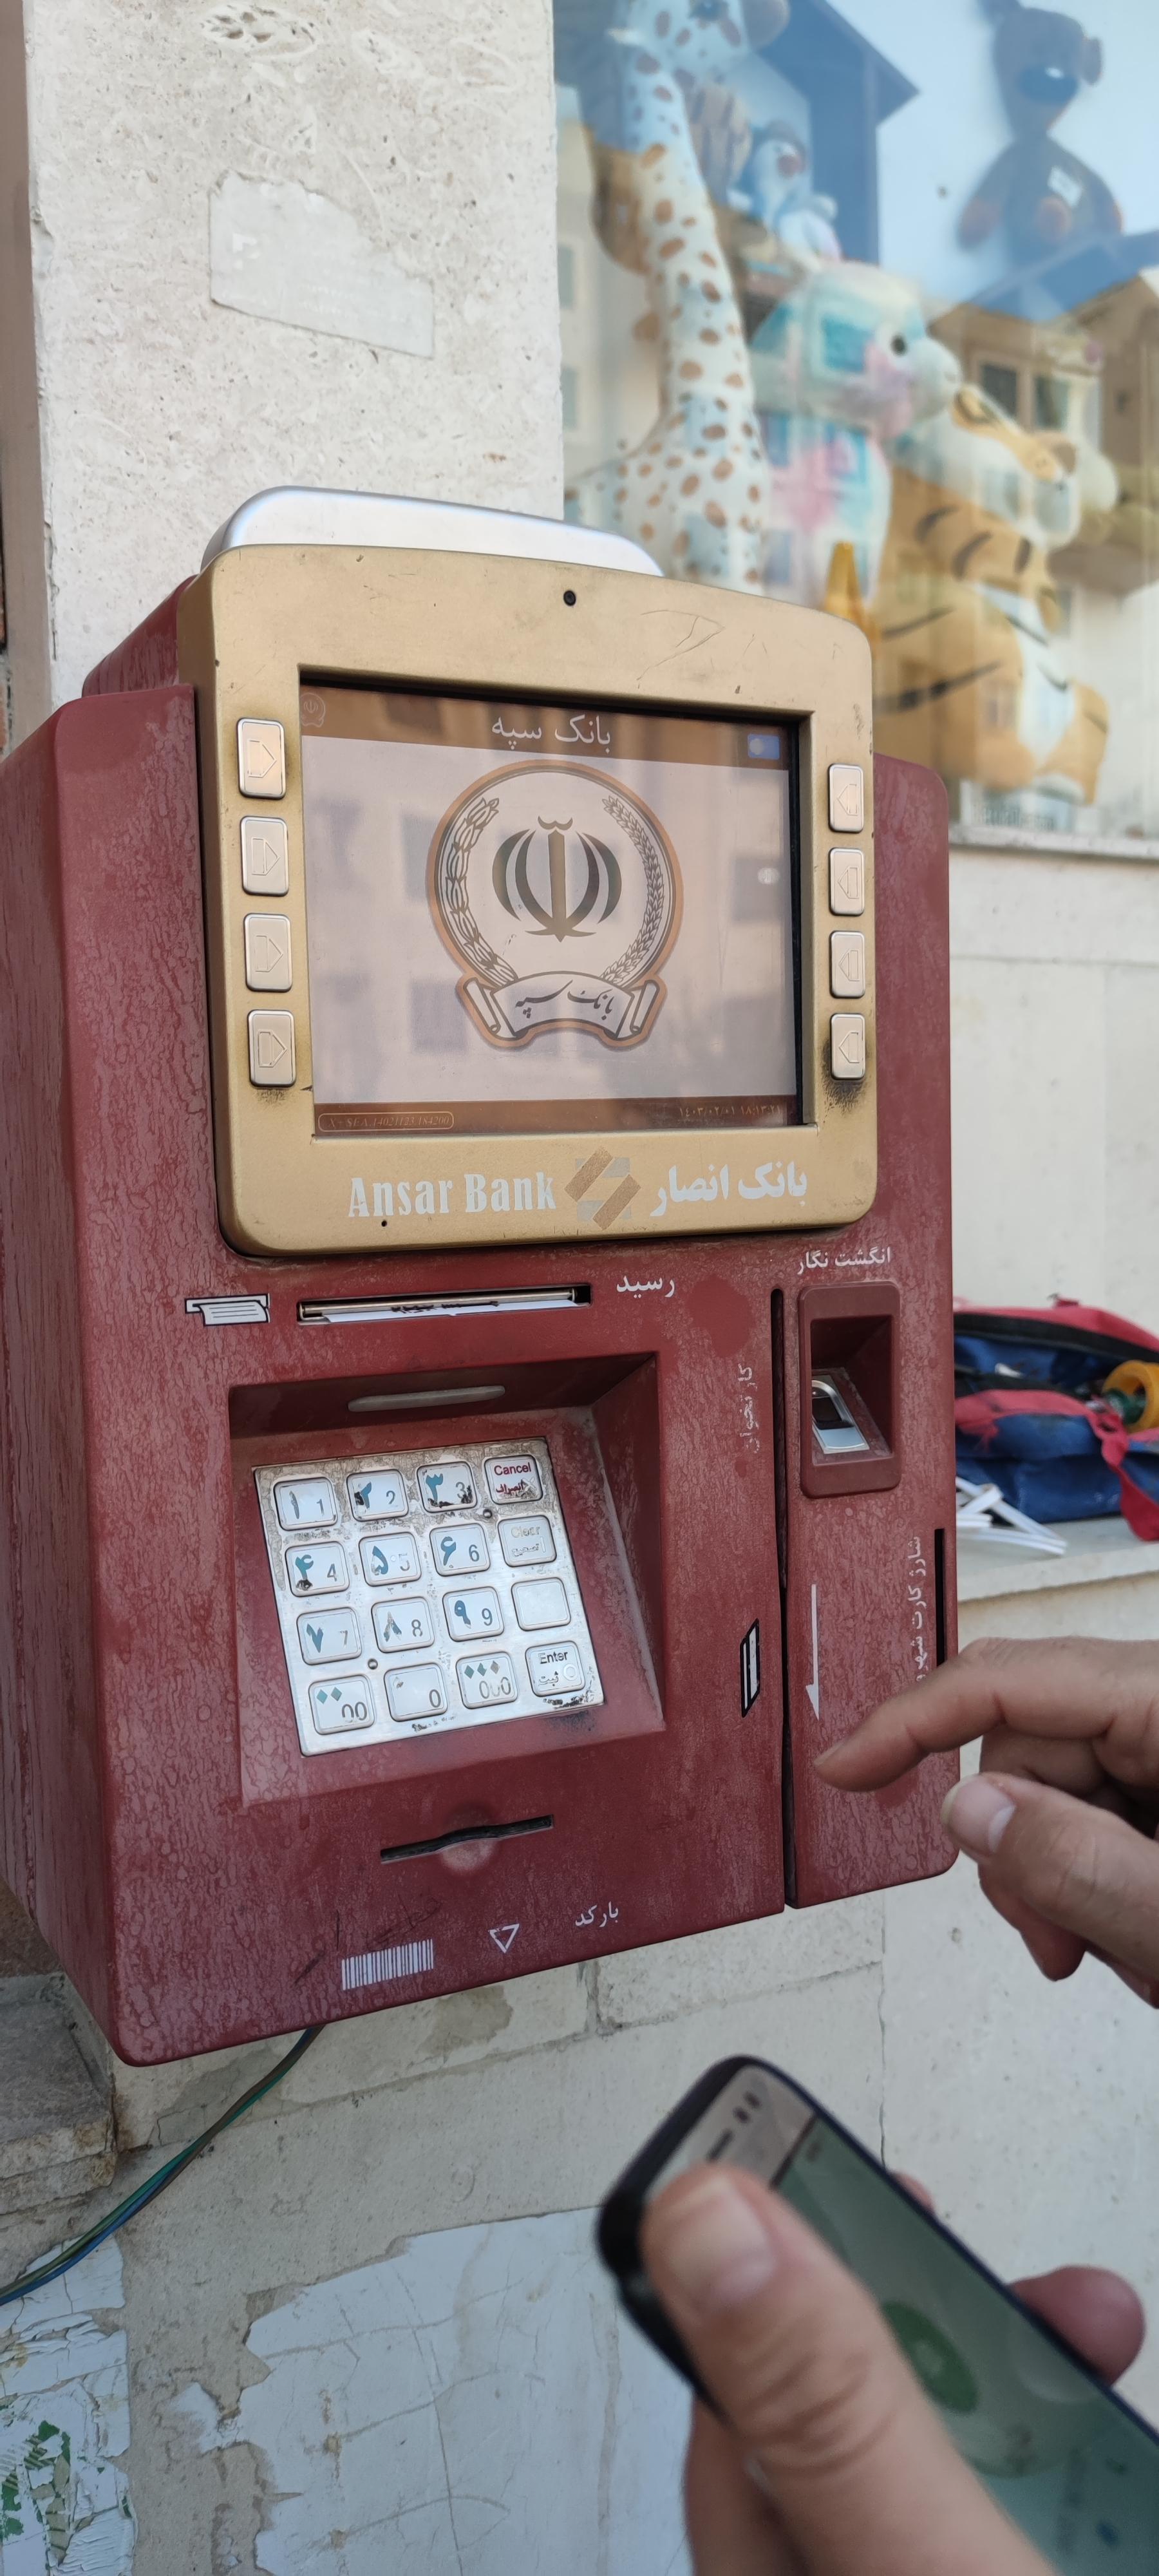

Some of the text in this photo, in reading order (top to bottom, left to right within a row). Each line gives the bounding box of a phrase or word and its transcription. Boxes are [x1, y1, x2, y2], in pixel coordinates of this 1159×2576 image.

[491, 715, 611, 753] بانک سپه
[515, 980, 615, 1021] بانک سپه
[348, 1171, 556, 1217] Ansar Bank
[650, 1160, 808, 1217] بانک انصار
[797, 1247, 891, 1275] انگشت نگار
[615, 1275, 676, 1298] رسید
[494, 1462, 532, 1476] Cancel
[386, 1490, 396, 1505] 2
[426, 1473, 466, 1502] ۳ 3
[316, 1498, 325, 1515] 1
[399, 1554, 410, 1572] 5
[440, 1537, 480, 1566] ۶ 6
[907, 1537, 926, 1577] شارژ
[295, 1554, 338, 1588] ۴ 4
[454, 1600, 493, 1629] ۹ 9
[907, 1585, 927, 1629] کارت
[306, 1623, 349, 1653] ۷ 7
[384, 1611, 423, 1642] ۸ 8
[538, 1651, 568, 1664] Enter
[538, 1671, 559, 1687] ثبت
[429, 1689, 441, 1708] 0
[575, 1901, 619, 1928] بارکد
